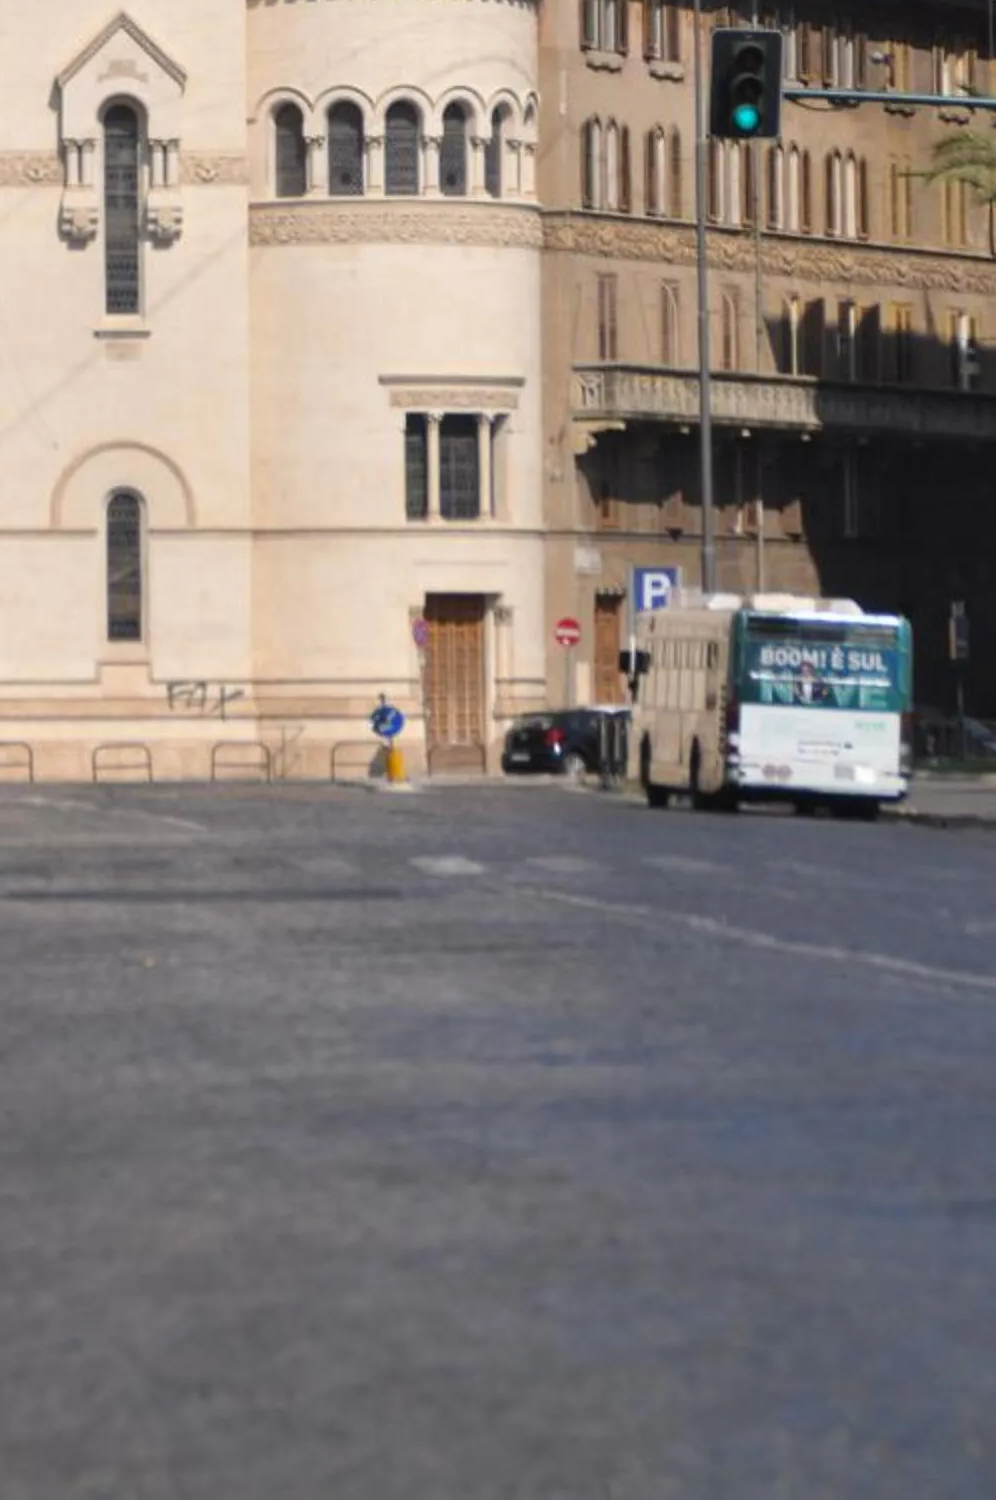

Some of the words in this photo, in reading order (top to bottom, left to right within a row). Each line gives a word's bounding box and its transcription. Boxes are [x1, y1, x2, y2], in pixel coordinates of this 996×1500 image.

[643, 572, 671, 609] P
[761, 645, 826, 669] BOOM!
[848, 651, 887, 673] SUL
